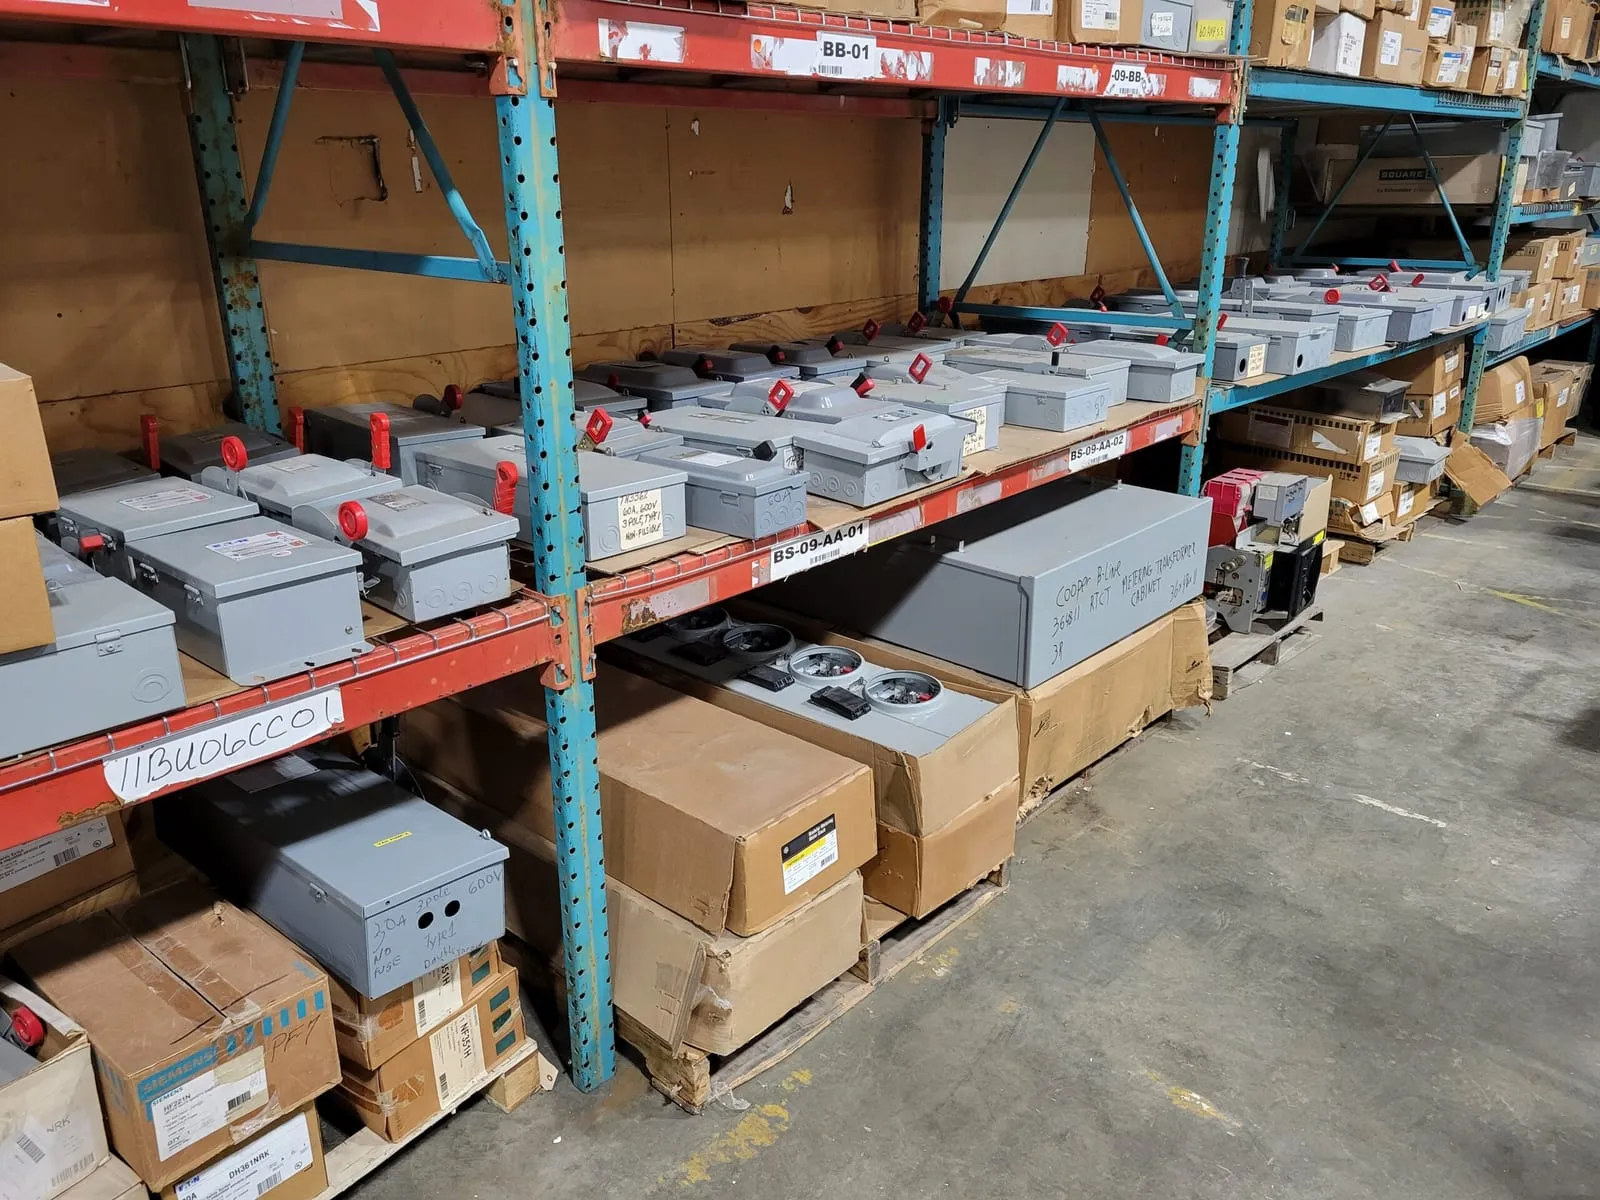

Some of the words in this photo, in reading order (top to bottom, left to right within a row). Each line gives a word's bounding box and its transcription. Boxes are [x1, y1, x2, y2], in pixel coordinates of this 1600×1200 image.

[1070, 434, 1125, 461] BS-09-AA-02
[773, 522, 864, 564] BS-09-AA-01
[1130, 577, 1162, 607] CABINET
[120, 696, 333, 793] 11BU06CC01
[468, 869, 503, 895] 600V
[460, 1022, 472, 1059] NF351H
[142, 1050, 214, 1092] SIEMENS
[152, 1087, 184, 1106] SIEMENS
[228, 1150, 270, 1180] DH361NRK
